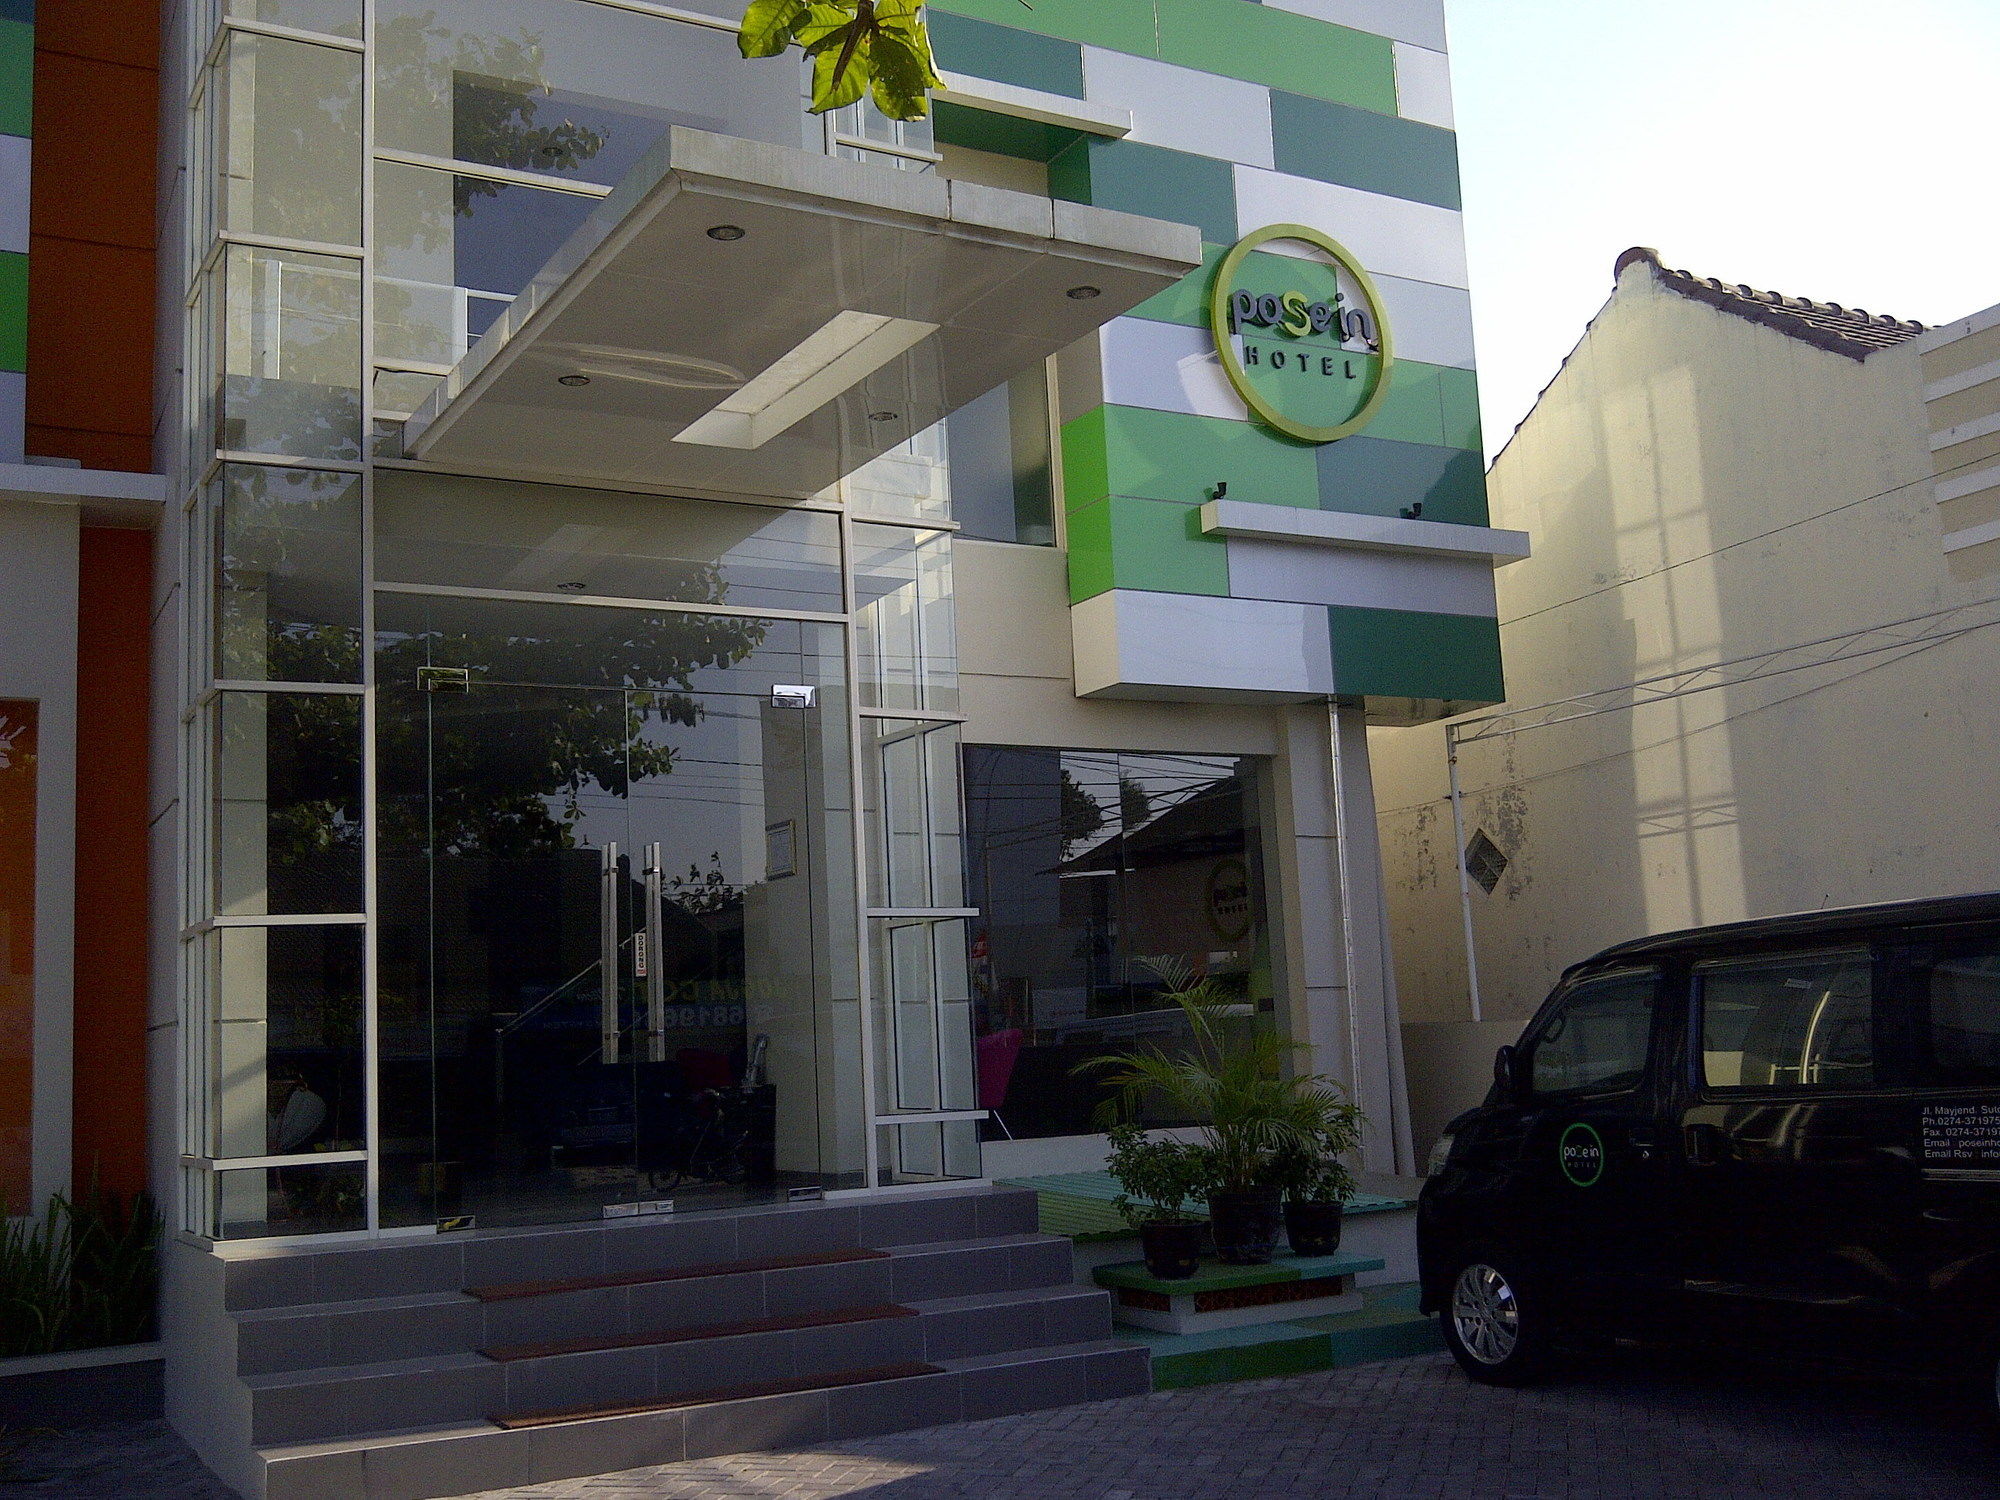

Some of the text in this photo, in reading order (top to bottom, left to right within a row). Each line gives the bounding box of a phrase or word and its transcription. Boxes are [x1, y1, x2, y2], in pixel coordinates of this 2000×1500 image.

[1245, 345, 1356, 380] HOTEL
[1924, 1139, 1950, 1148] Email
[1924, 1149, 1951, 1158] Email
